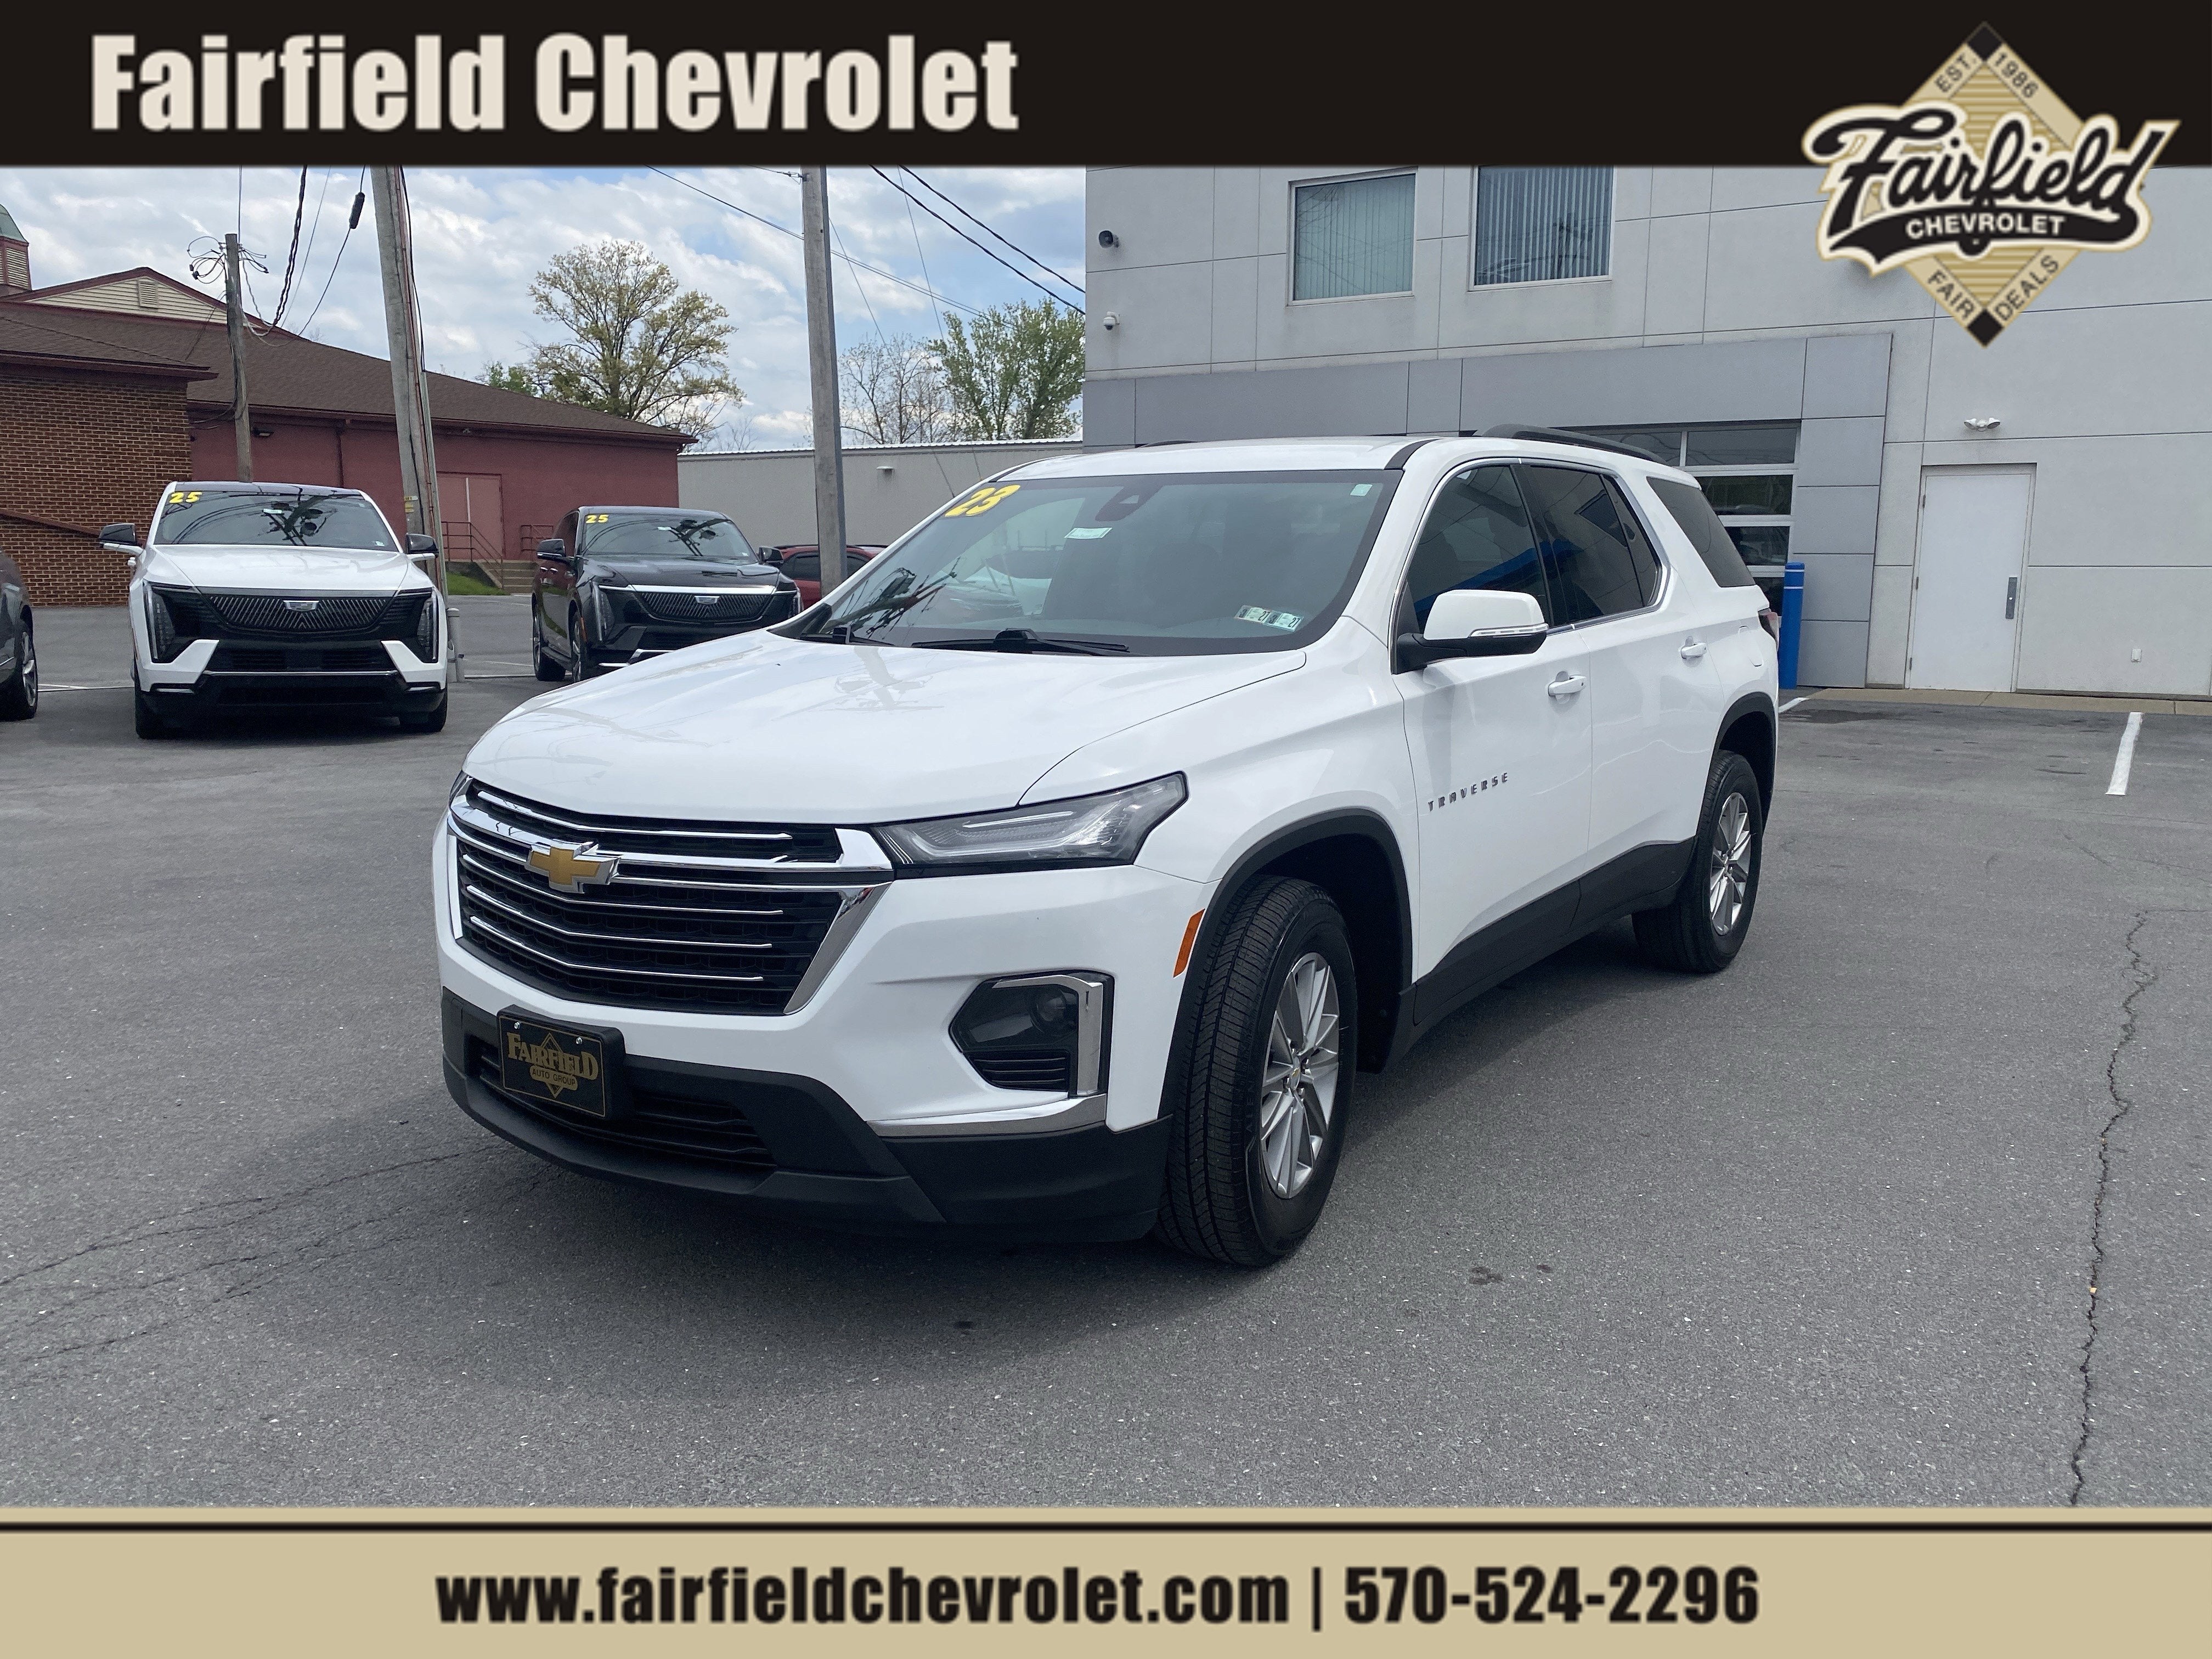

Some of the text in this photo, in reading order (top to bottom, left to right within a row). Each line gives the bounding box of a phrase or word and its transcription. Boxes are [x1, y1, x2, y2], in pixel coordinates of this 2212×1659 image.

[168, 491, 203, 504] 25
[944, 484, 1022, 517] 23
[585, 514, 610, 524] 25
[1258, 611, 1271, 622] 27
[1288, 617, 1301, 628] 27
[1427, 772, 1508, 812] TRAVERSE
[506, 1031, 599, 1081] FAIRFIELD
[532, 1068, 576, 1086] AUTO GROUP
